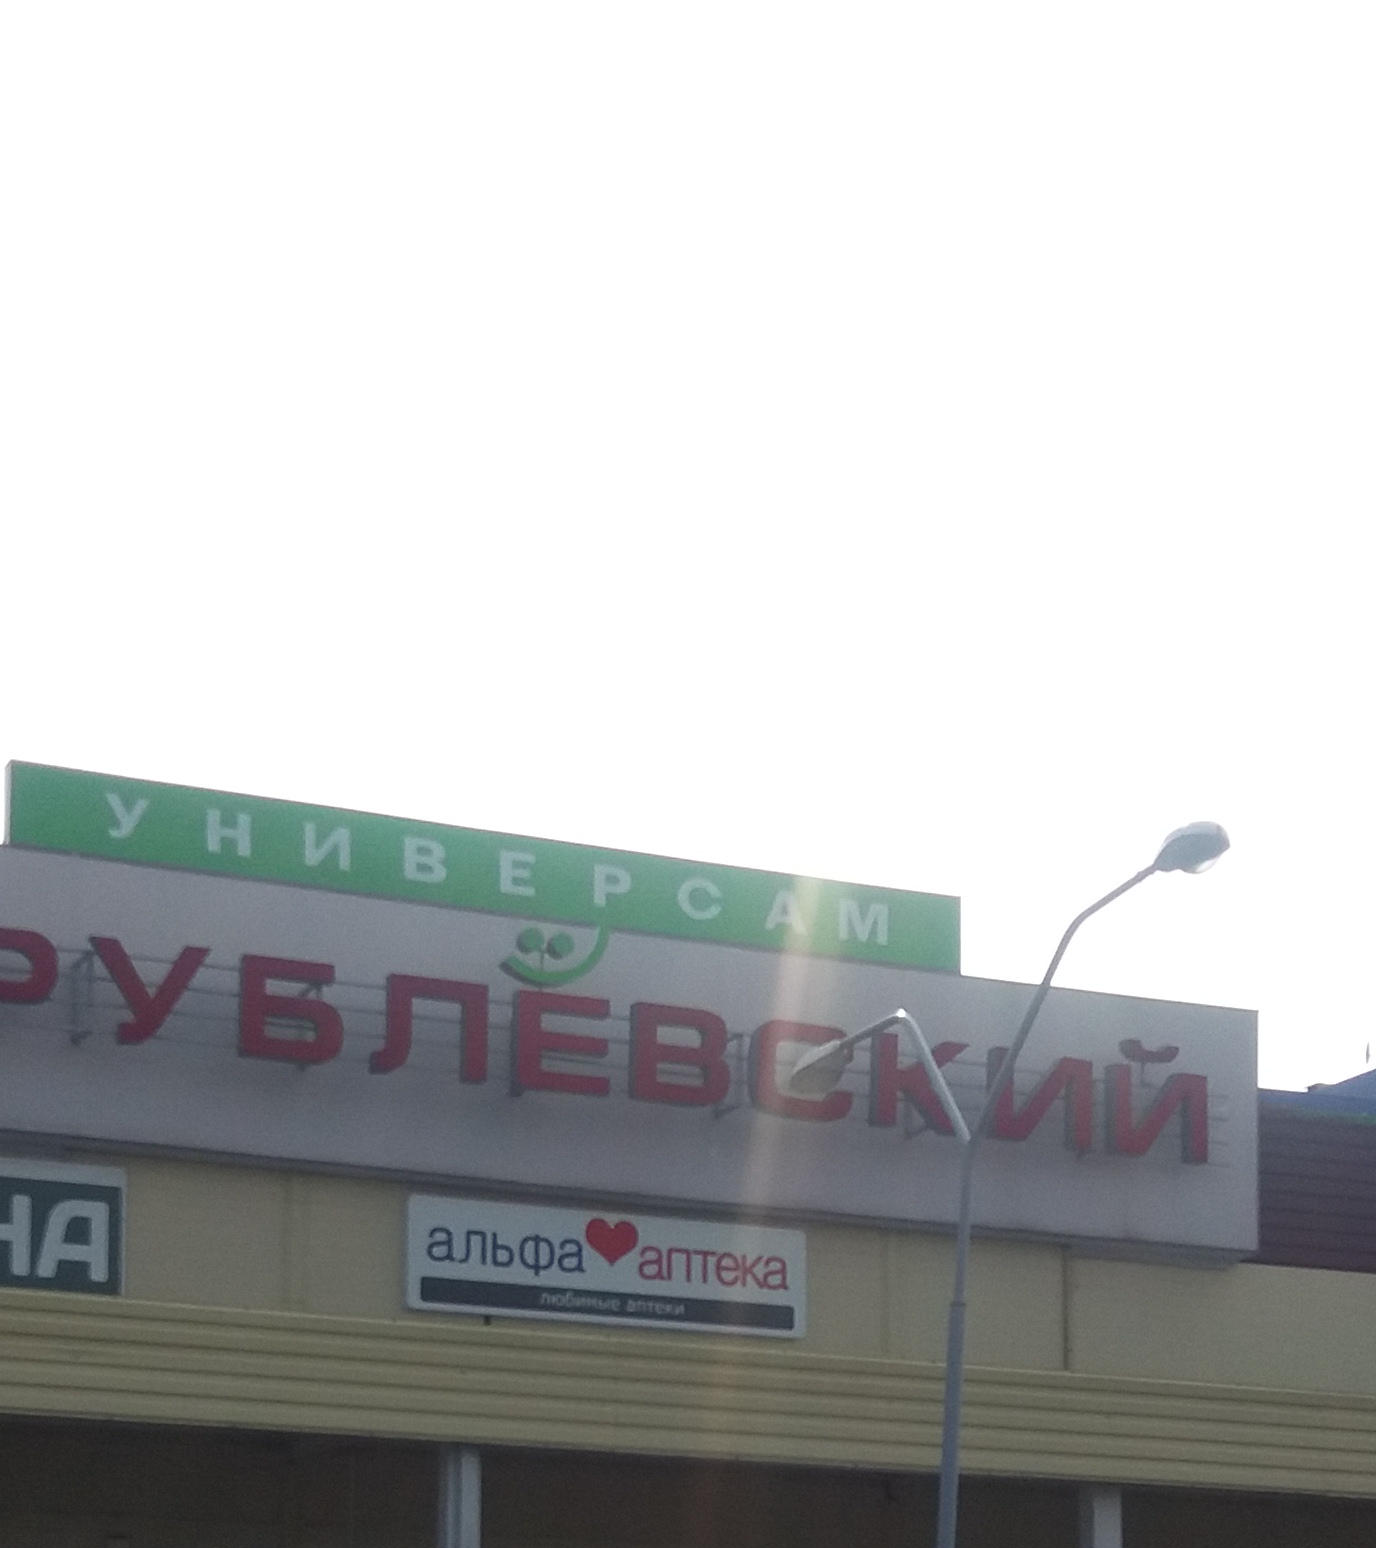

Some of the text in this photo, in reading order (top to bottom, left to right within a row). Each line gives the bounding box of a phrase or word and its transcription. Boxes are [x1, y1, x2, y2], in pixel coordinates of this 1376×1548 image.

[106, 792, 889, 946] УНИВЕРСАМ
[426, 1226, 790, 1291] альфа аптека
